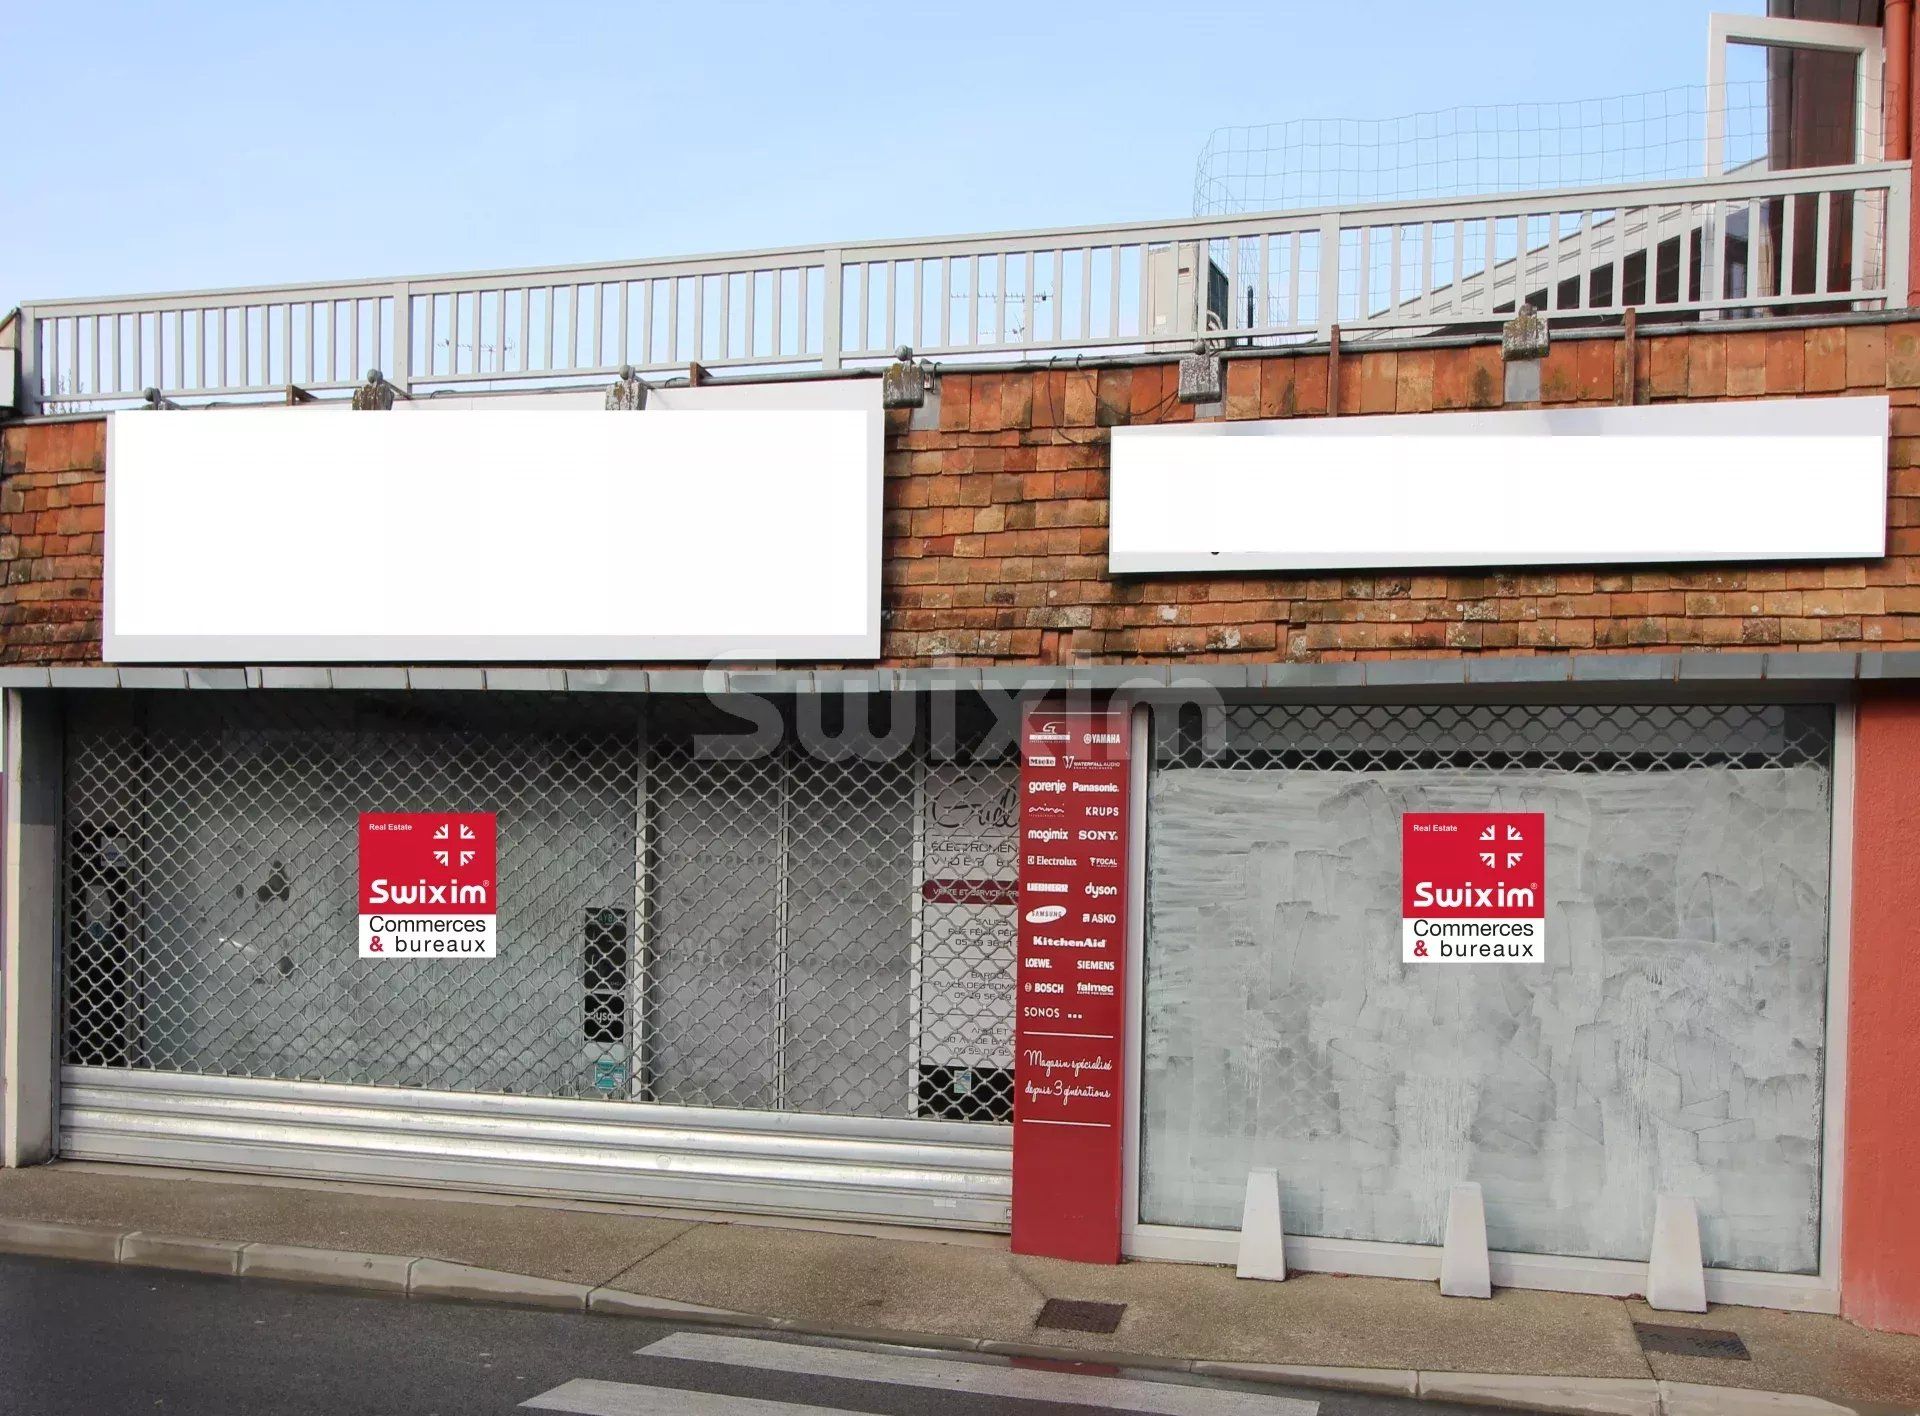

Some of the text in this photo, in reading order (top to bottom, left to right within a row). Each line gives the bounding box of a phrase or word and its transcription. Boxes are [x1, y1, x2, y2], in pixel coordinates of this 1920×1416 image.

[1092, 734, 1120, 744] YAMAHA
[1029, 779, 1066, 794] gorenje
[1085, 807, 1119, 817] KRUPS
[1028, 828, 1068, 842] magimix
[1078, 830, 1118, 840] SONY
[1036, 856, 1077, 866] Electrolux
[1085, 882, 1117, 898] dyson
[1032, 907, 1062, 918] SAMSUNG
[1091, 914, 1117, 924] ASKO
[1033, 936, 1106, 948] KitchenAid
[1077, 960, 1114, 970] SIEMENS
[1034, 983, 1064, 993] BOSCH
[1077, 982, 1114, 992] falmec
[1024, 1007, 1060, 1018] SONOS
[1024, 1049, 1112, 1077] Magasin spécialisé
[1025, 1080, 1112, 1105] depuis 3 générations
